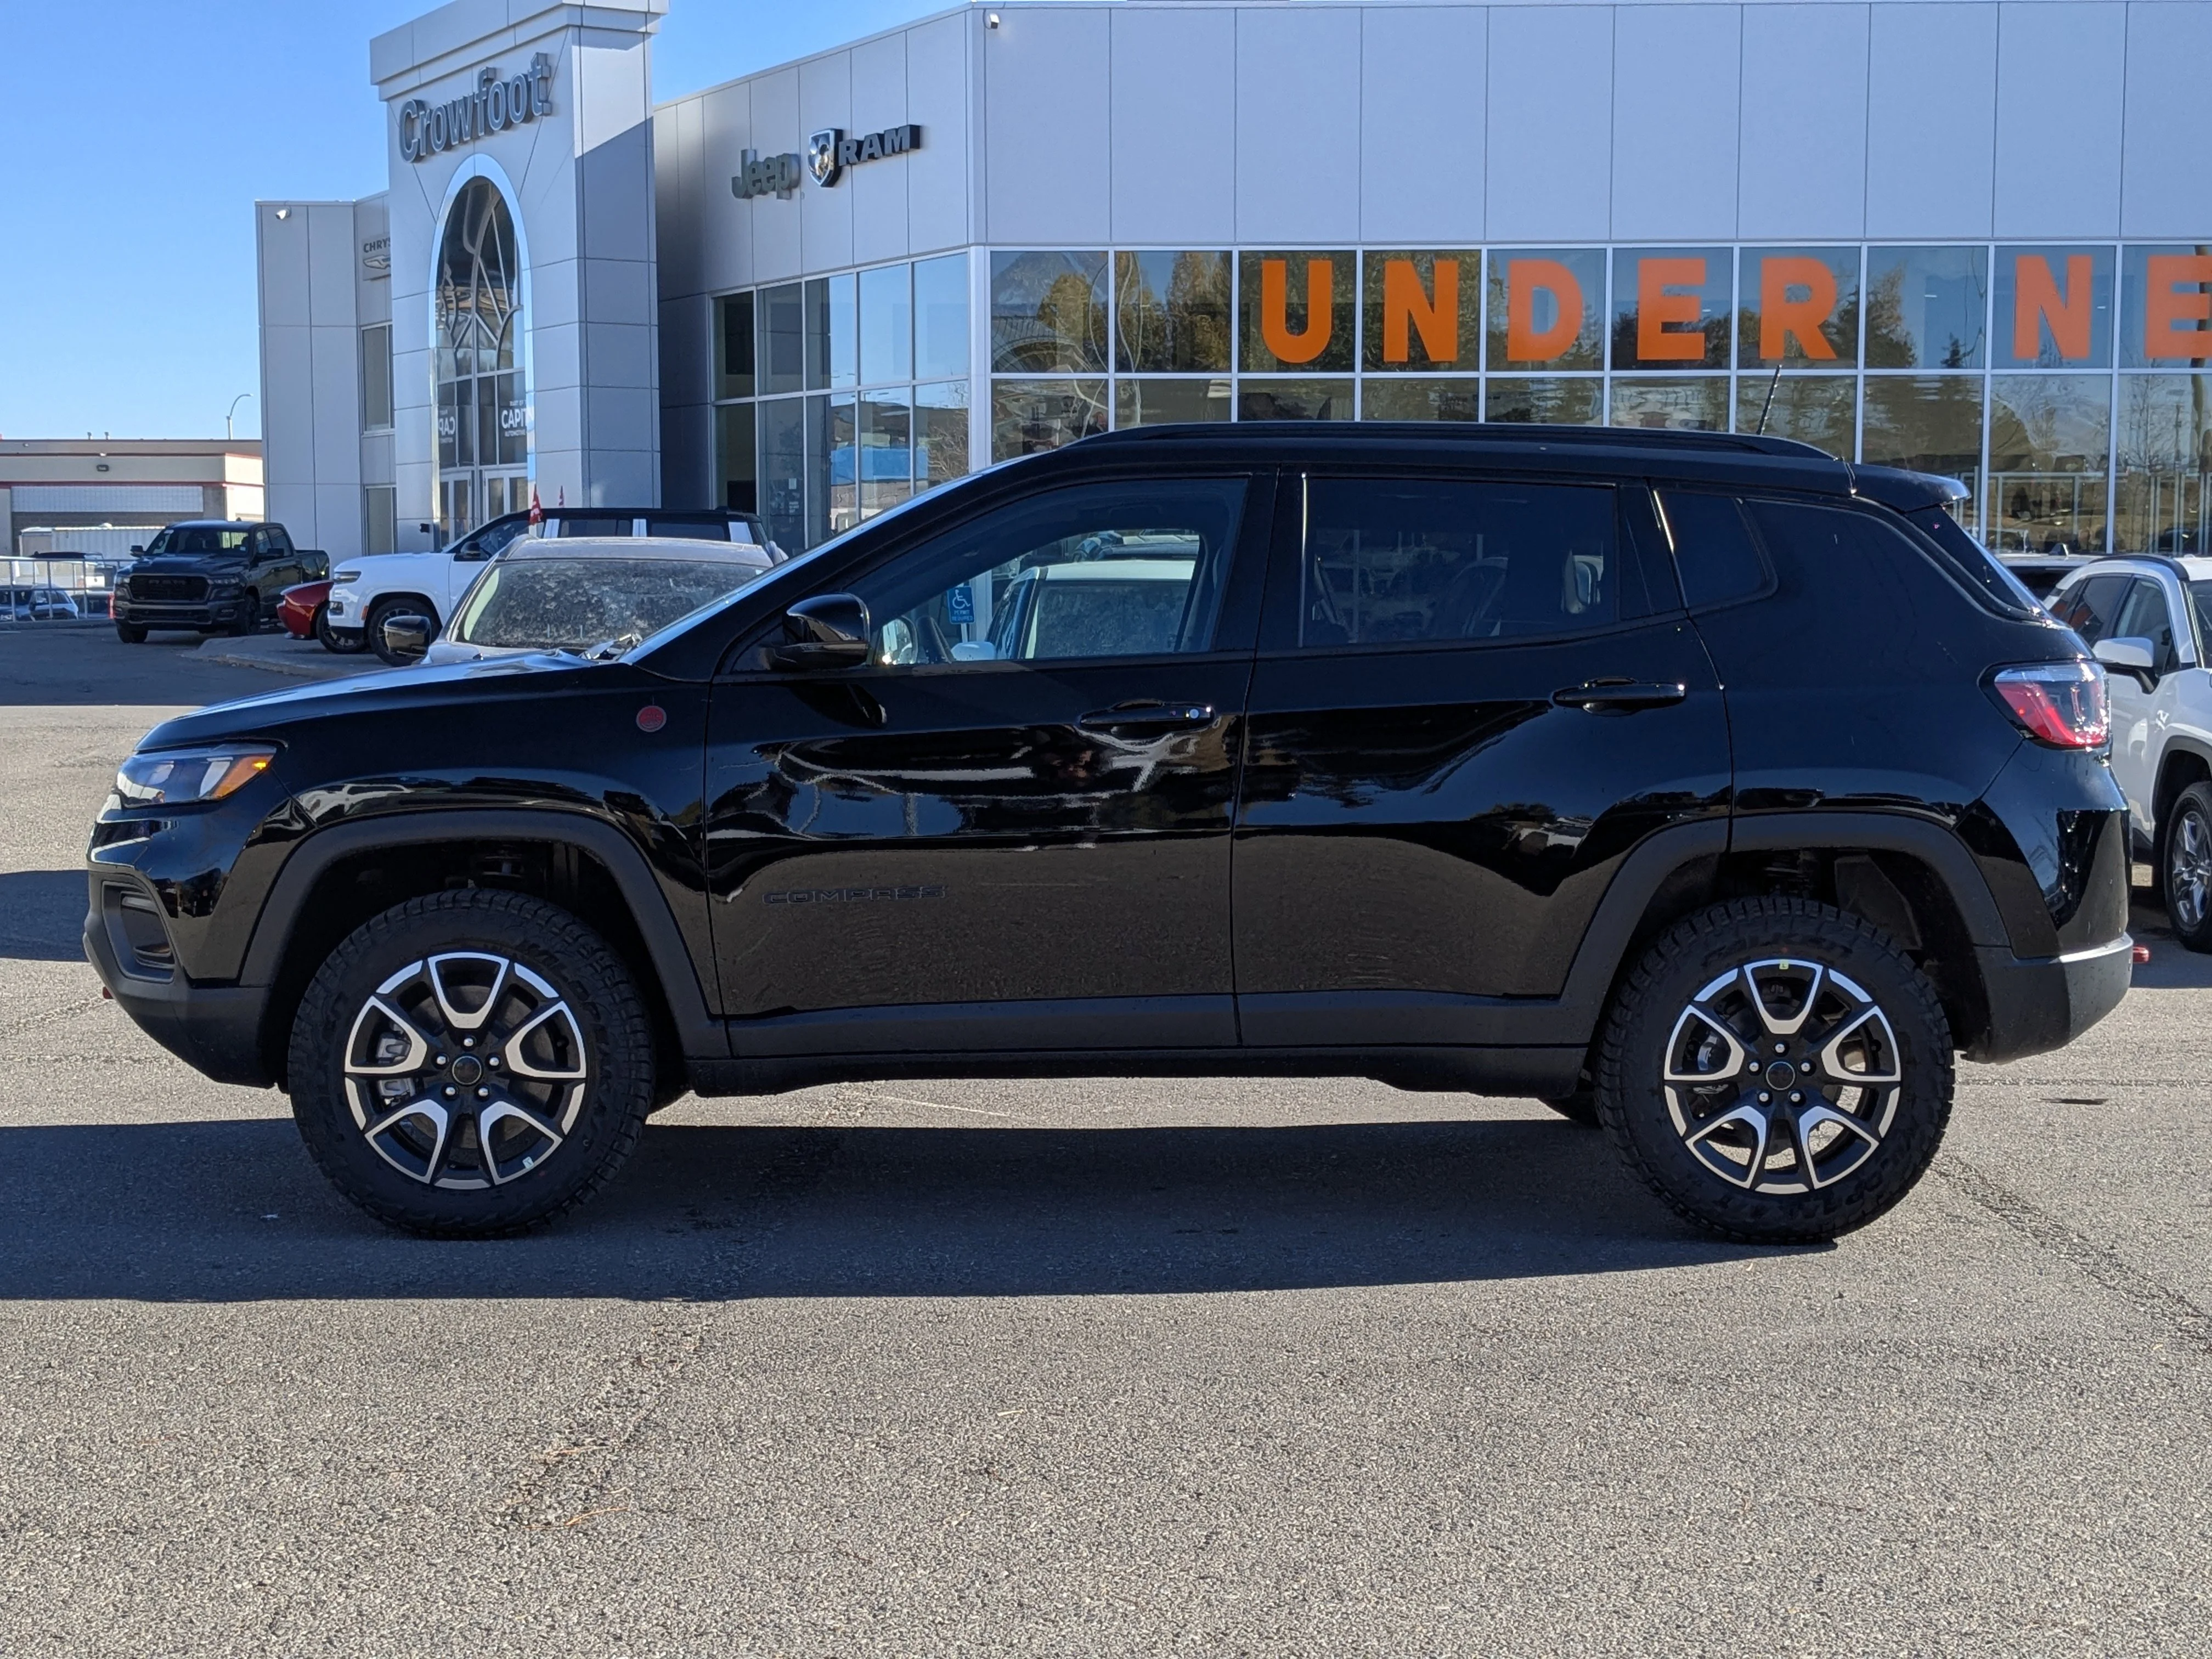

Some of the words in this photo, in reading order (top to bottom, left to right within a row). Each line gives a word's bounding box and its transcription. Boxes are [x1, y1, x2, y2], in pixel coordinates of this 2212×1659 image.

[399, 52, 552, 163] Crowfoot
[838, 124, 921, 166] RAM
[732, 149, 800, 200] Jeep
[1261, 256, 1837, 363] UNDER
[2013, 255, 2212, 360] NE
[762, 885, 946, 905] COMPASS
